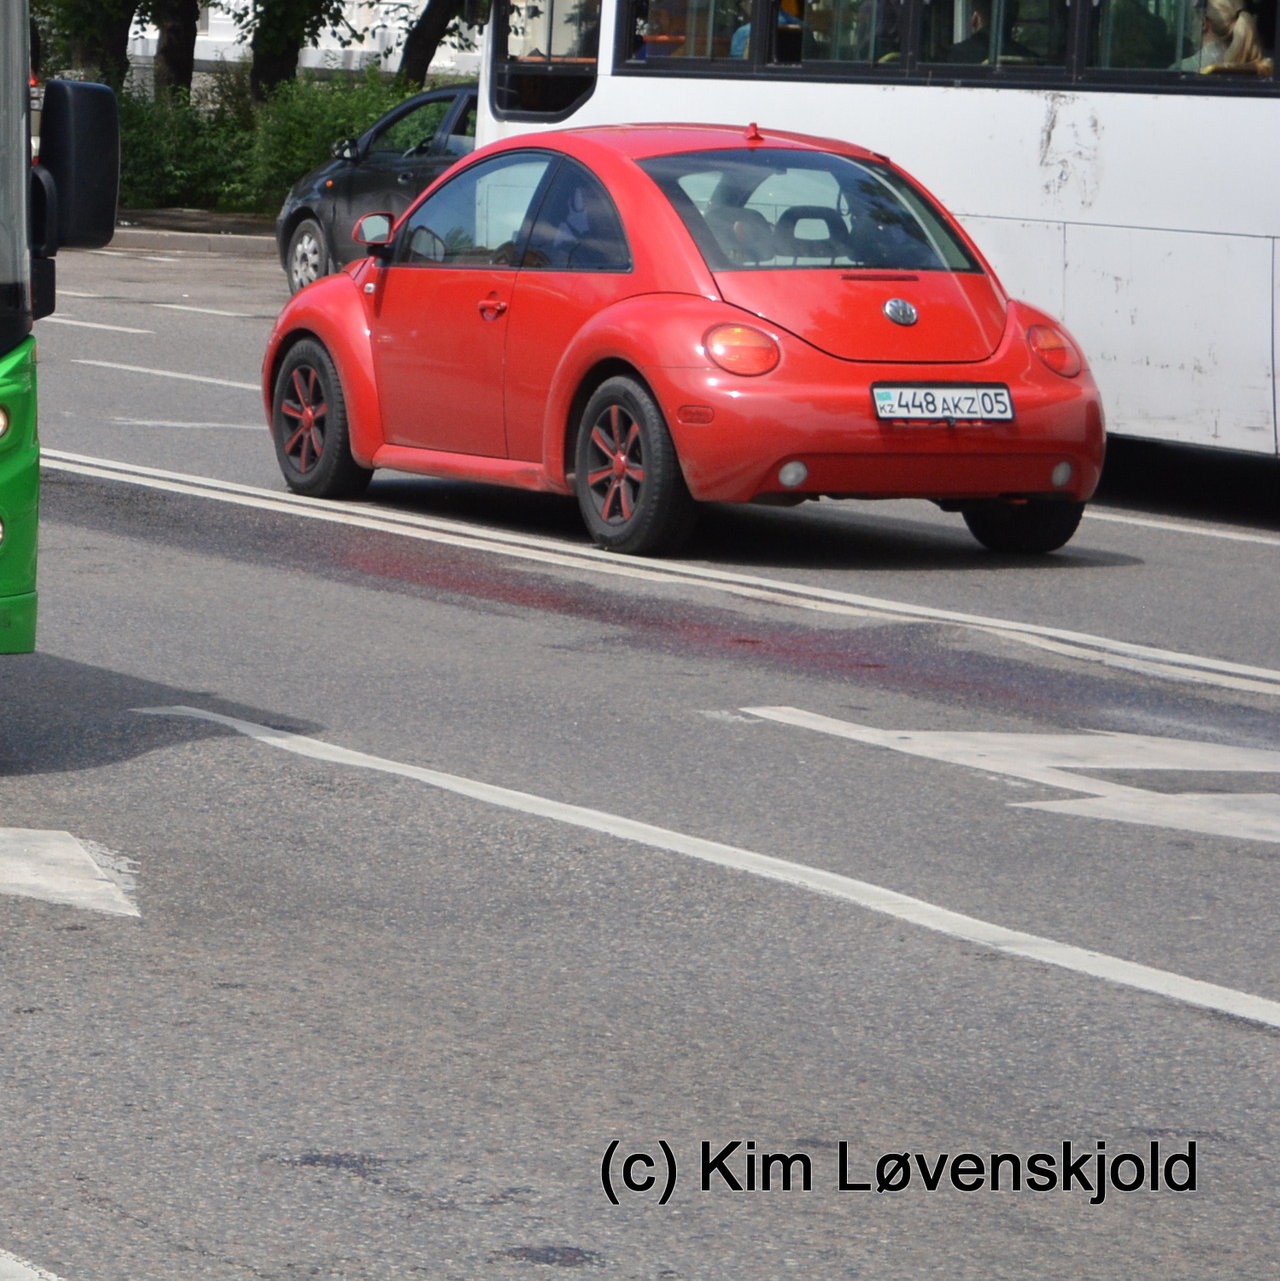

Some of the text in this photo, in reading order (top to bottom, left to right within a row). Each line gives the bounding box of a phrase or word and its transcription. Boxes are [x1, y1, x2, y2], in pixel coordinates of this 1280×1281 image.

[879, 391, 1009, 415] KZ 448 AKZ 05
